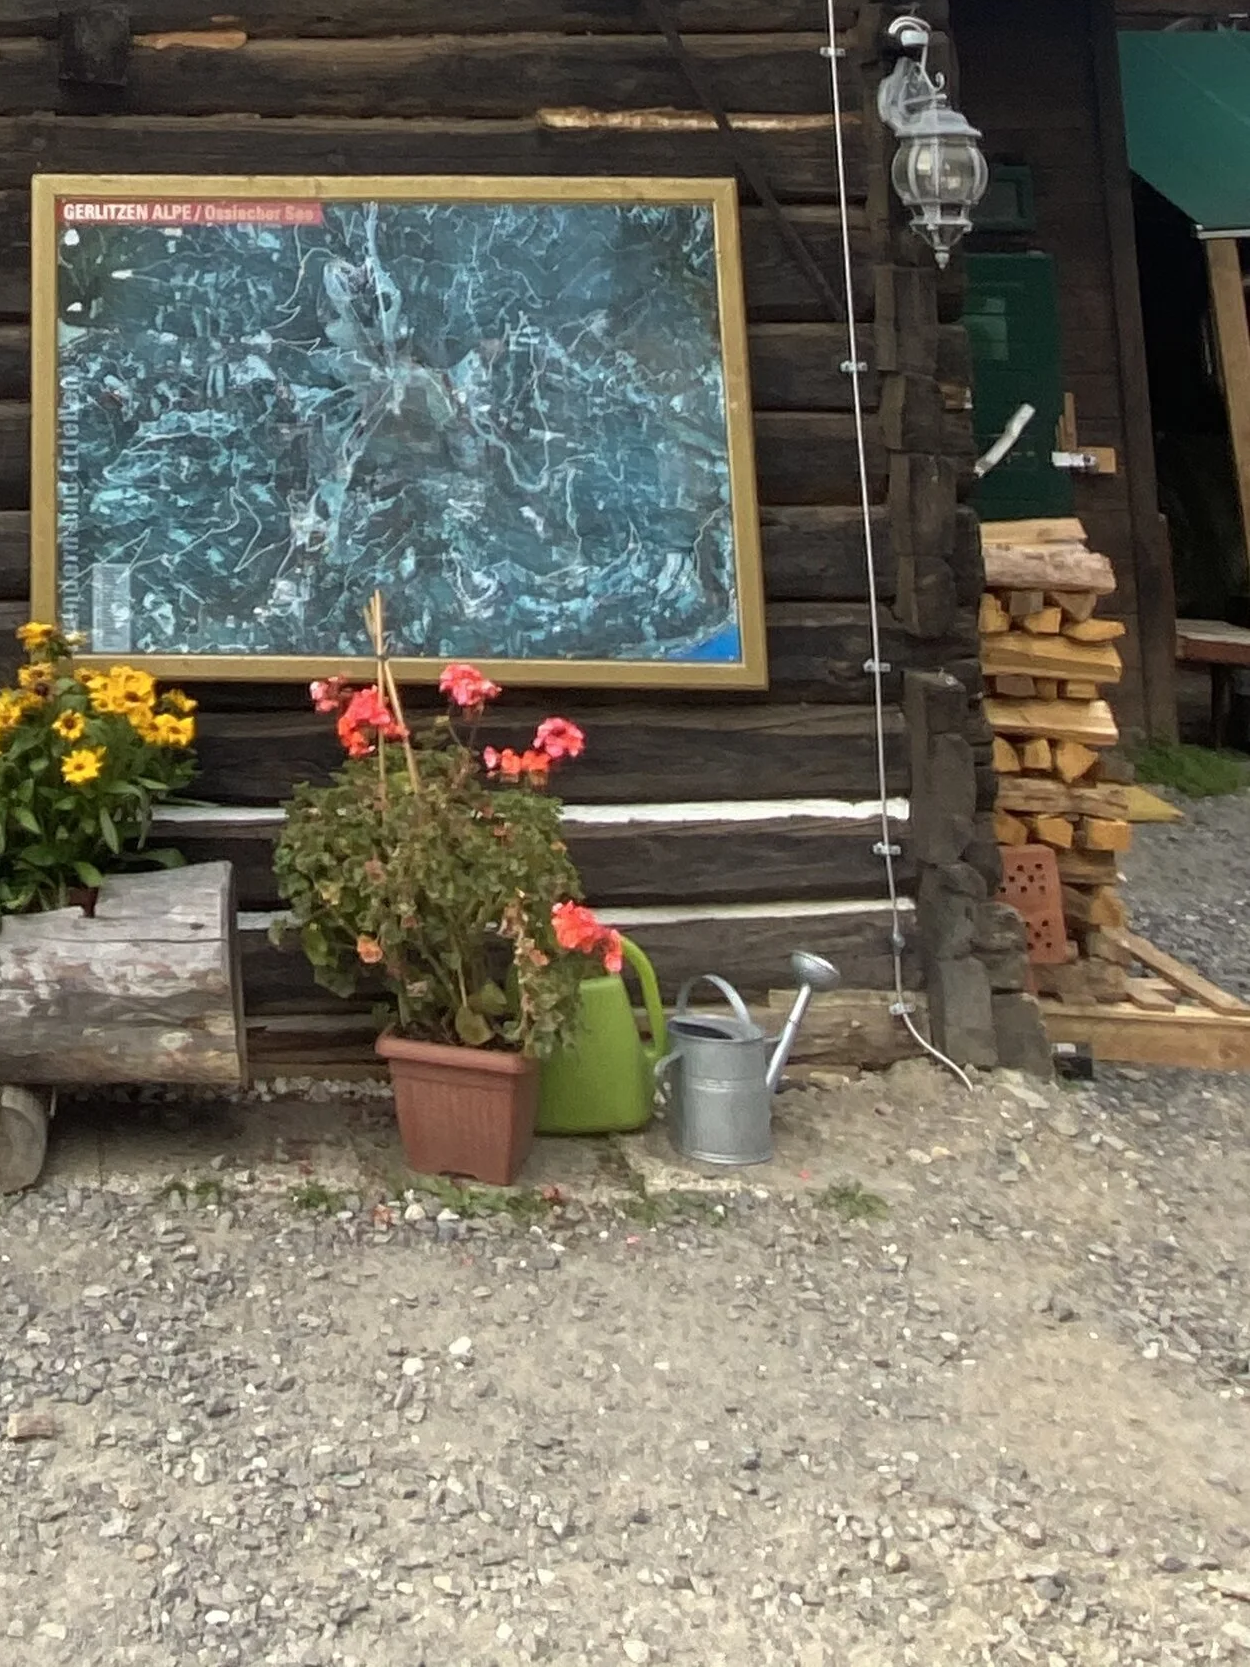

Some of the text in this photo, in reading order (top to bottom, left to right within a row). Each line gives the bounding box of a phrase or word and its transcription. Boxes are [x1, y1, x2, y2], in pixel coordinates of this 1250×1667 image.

[63, 202, 149, 221] GERLITZEN
[152, 203, 192, 221] ALPE
[205, 205, 281, 221] Ossiacher
[285, 205, 314, 222] See
